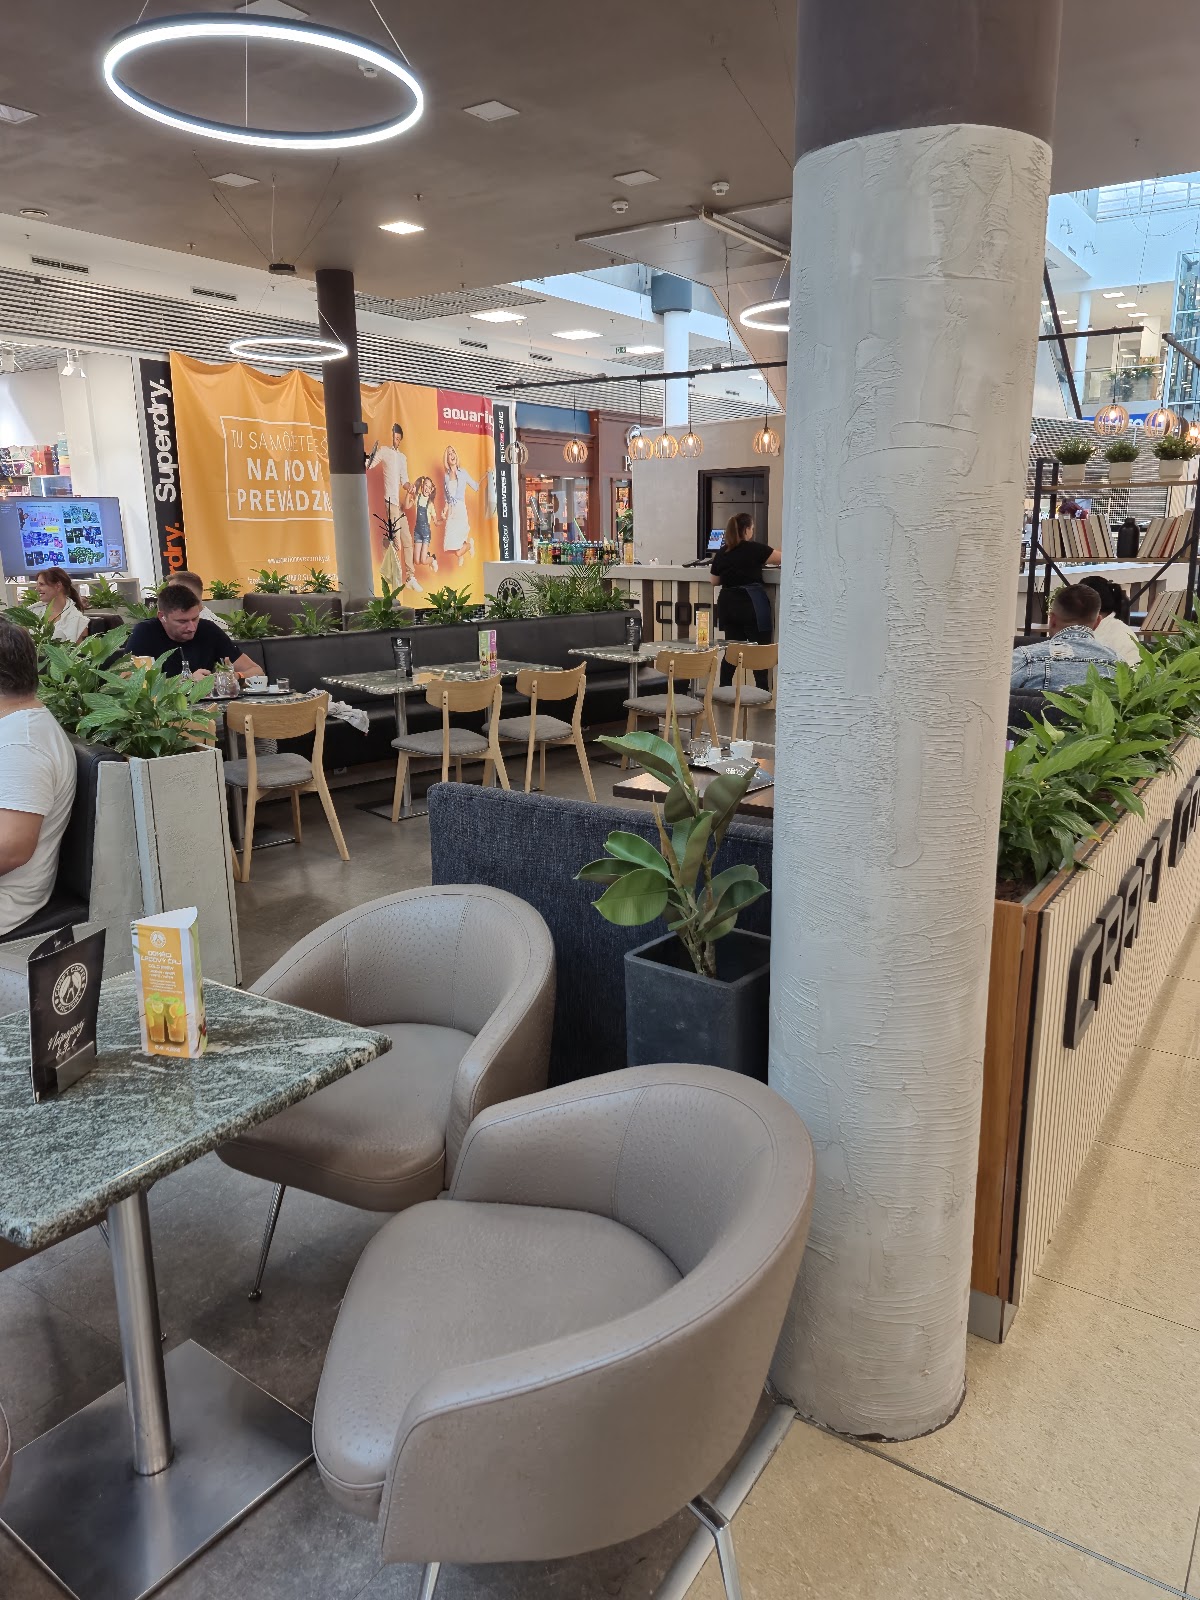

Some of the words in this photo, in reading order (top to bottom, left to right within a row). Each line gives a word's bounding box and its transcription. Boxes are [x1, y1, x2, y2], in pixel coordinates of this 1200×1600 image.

[146, 378, 179, 503] Superdry.
[230, 429, 244, 449] TU
[246, 457, 279, 481] NA
[284, 459, 324, 482] NOV
[500, 470, 508, 518] CONVERSE
[1062, 818, 1172, 1050] CRAFT
[1167, 768, 1200, 868] CO
[54, 969, 71, 997] CRAFT
